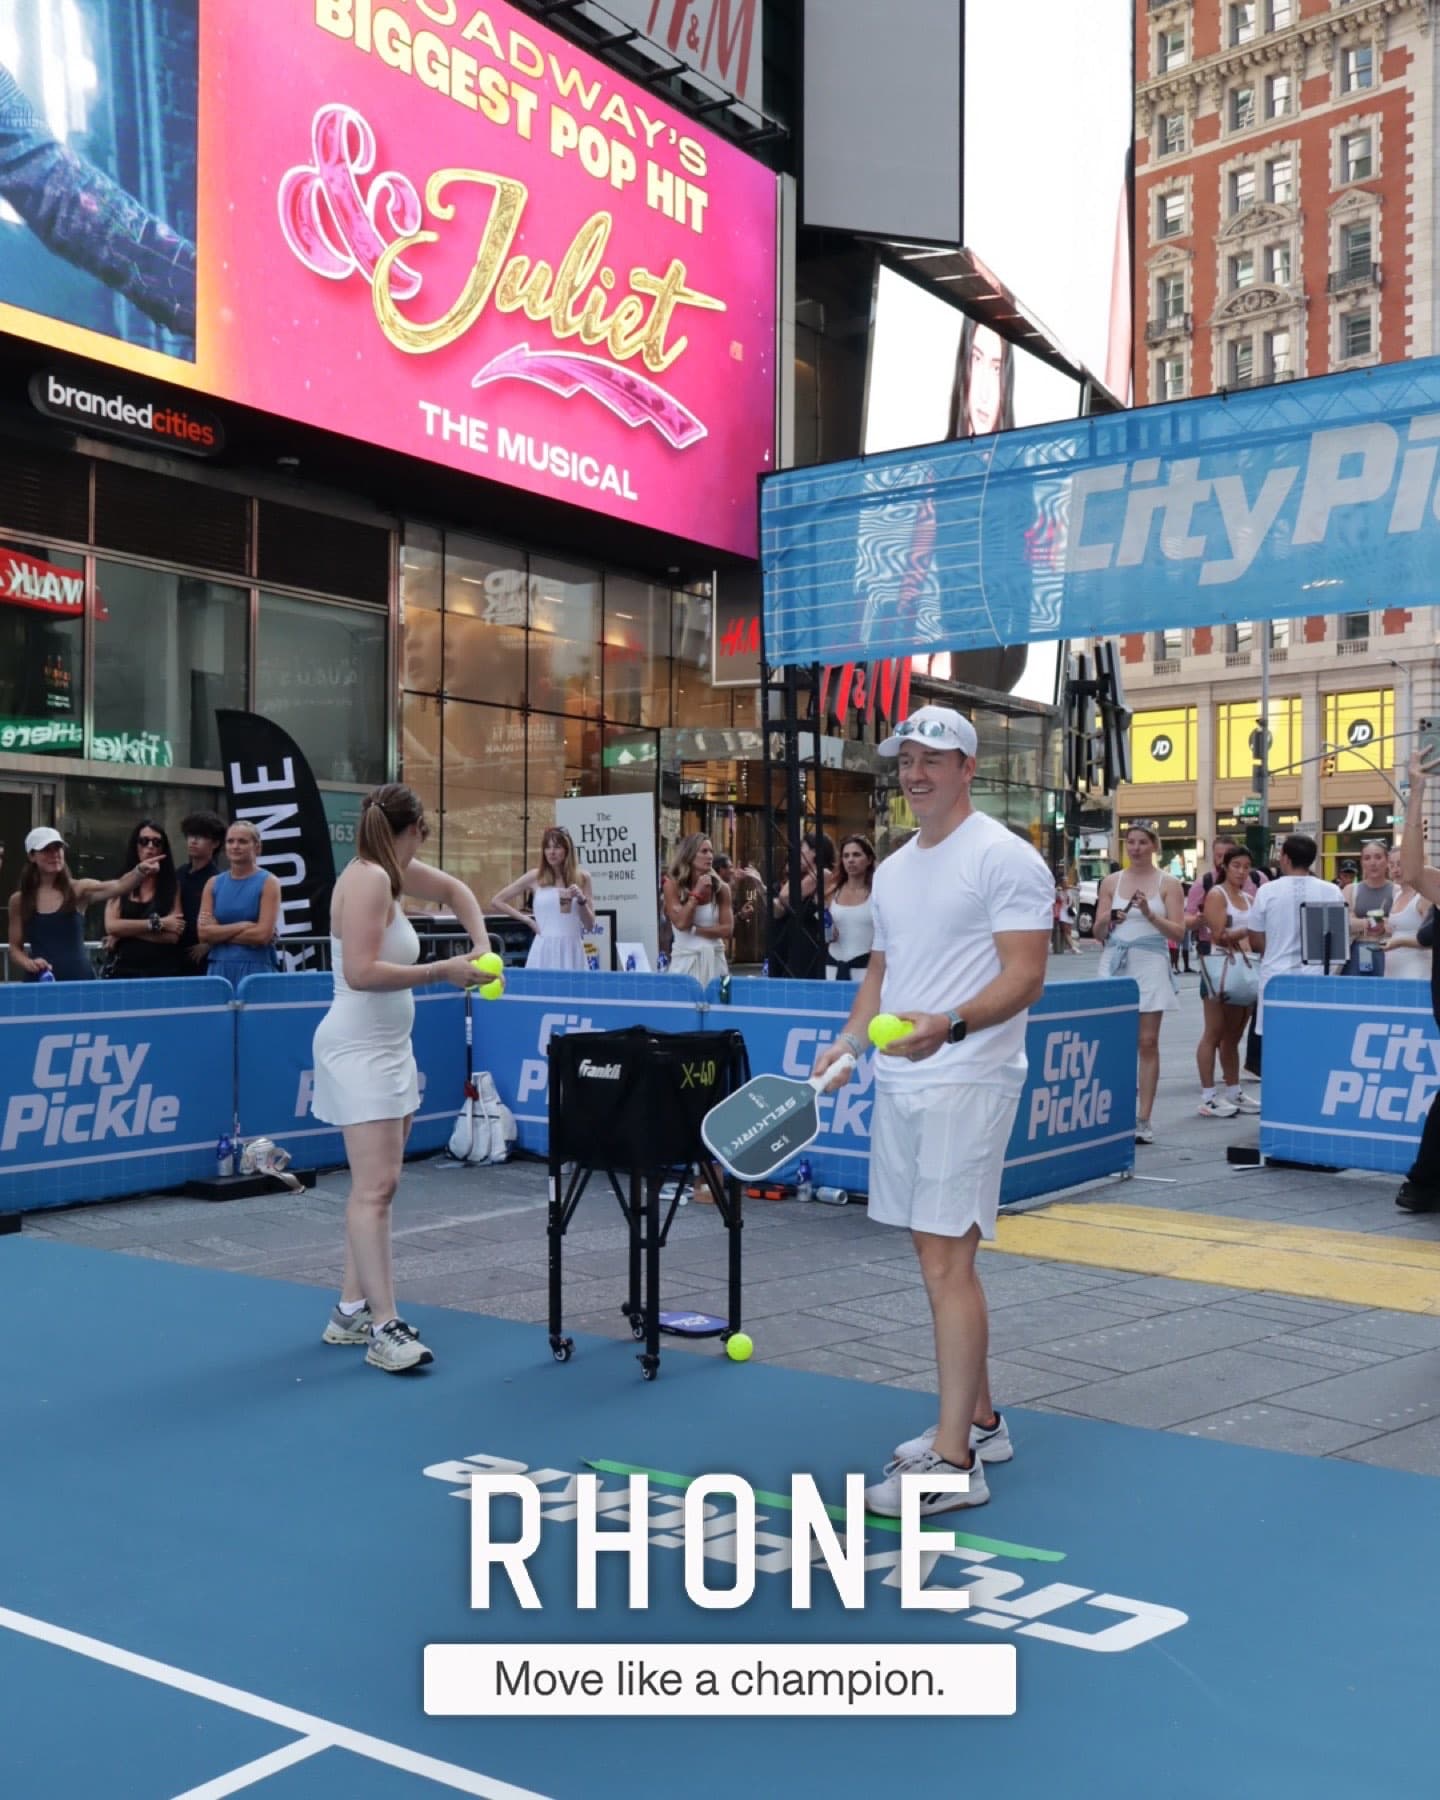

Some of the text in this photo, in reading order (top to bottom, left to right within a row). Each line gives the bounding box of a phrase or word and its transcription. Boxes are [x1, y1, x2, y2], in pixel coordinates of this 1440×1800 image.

[315, 0, 709, 235] BIGGEST POP HIT
[277, 103, 728, 373] & Juliet
[48, 376, 216, 446] brandedcities
[417, 399, 639, 501] THE MUSICAL
[1064, 413, 1440, 586] CityPi
[1151, 739, 1171, 755] JD
[1349, 724, 1371, 741] JD
[580, 824, 629, 847] Hype
[596, 812, 612, 822] The
[1337, 803, 1374, 832] JD
[576, 842, 638, 864] Tunnel
[608, 870, 636, 880] RHONE
[32, 1032, 151, 1096] City
[680, 1060, 717, 1089] X-40
[1043, 1030, 1100, 1094] City
[1, 1083, 181, 1151] Pickle
[730, 1096, 798, 1151] SELKIRK
[1027, 1079, 1113, 1142] Pickle
